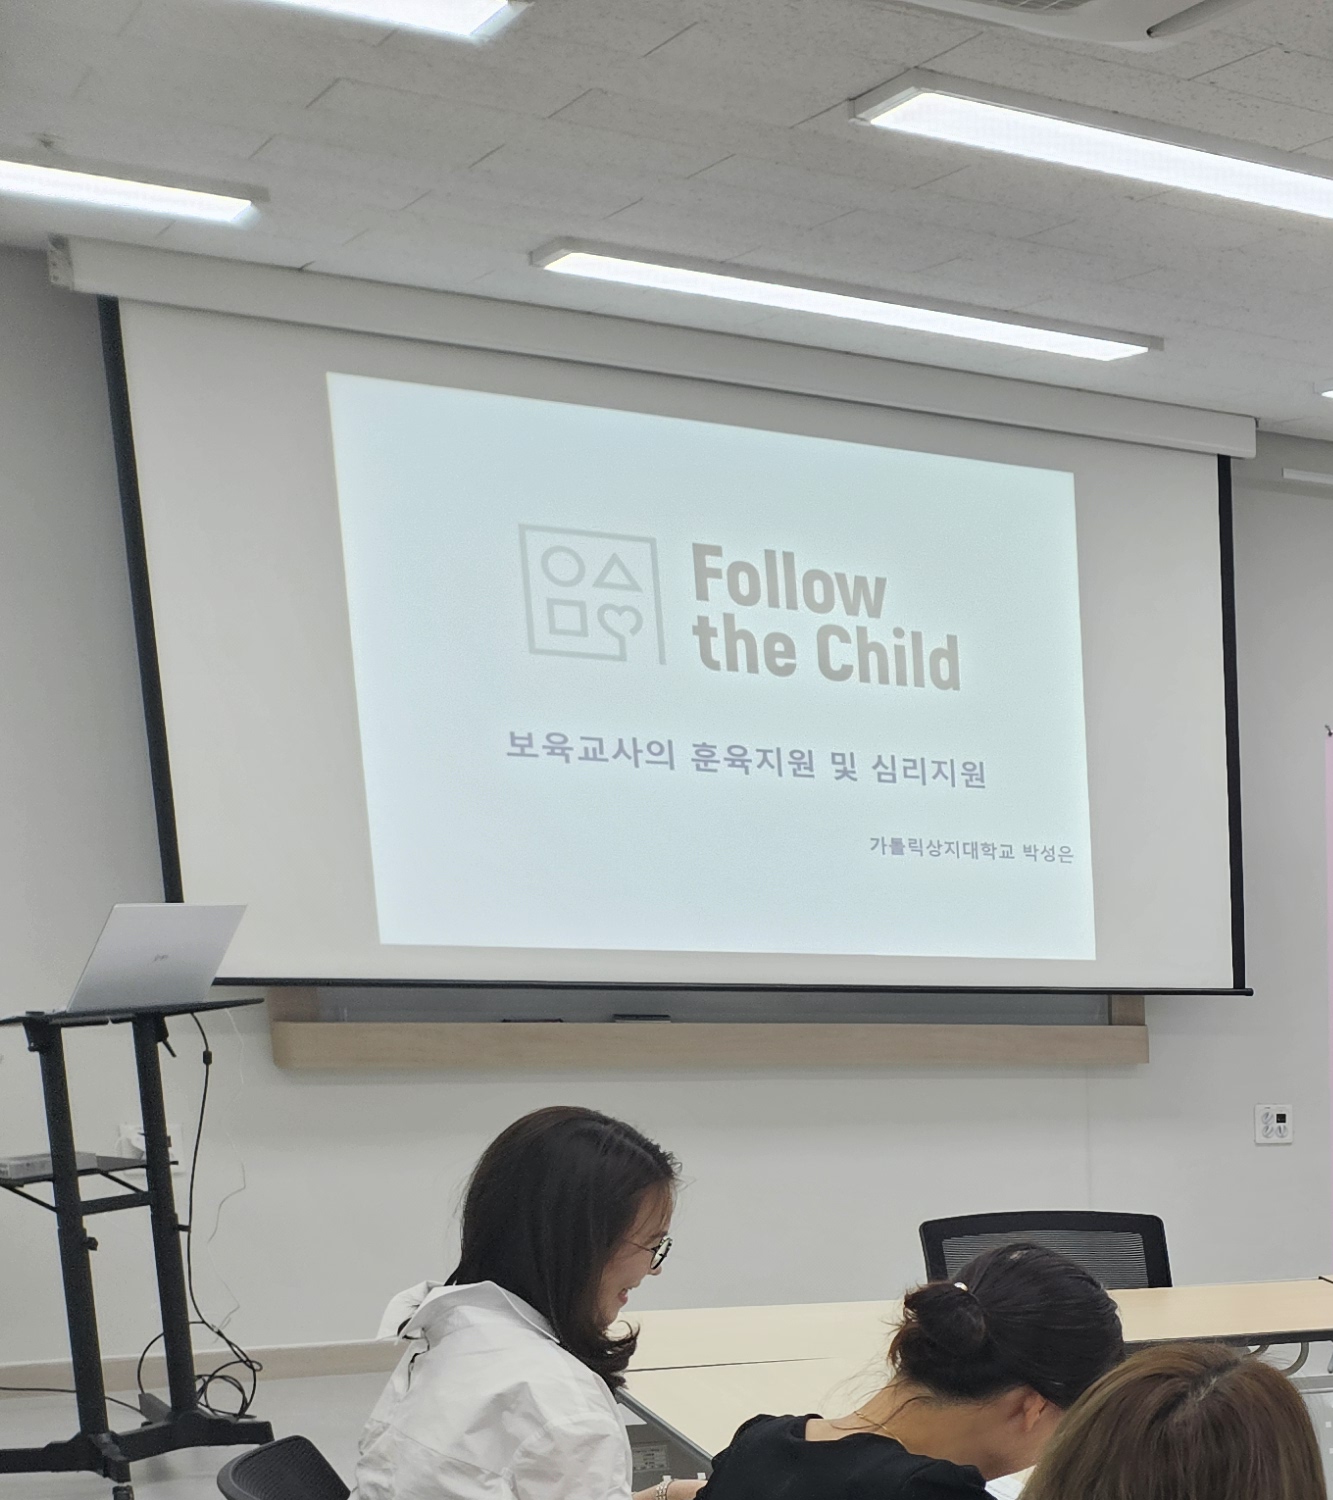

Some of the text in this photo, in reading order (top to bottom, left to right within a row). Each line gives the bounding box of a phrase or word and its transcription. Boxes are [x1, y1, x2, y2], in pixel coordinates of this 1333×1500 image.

[691, 543, 888, 619] Follow
[692, 613, 961, 691] the Child
[506, 730, 987, 790] 보육교사의 훈육지원 및 심리지원
[1022, 843, 1074, 864] 박성은
